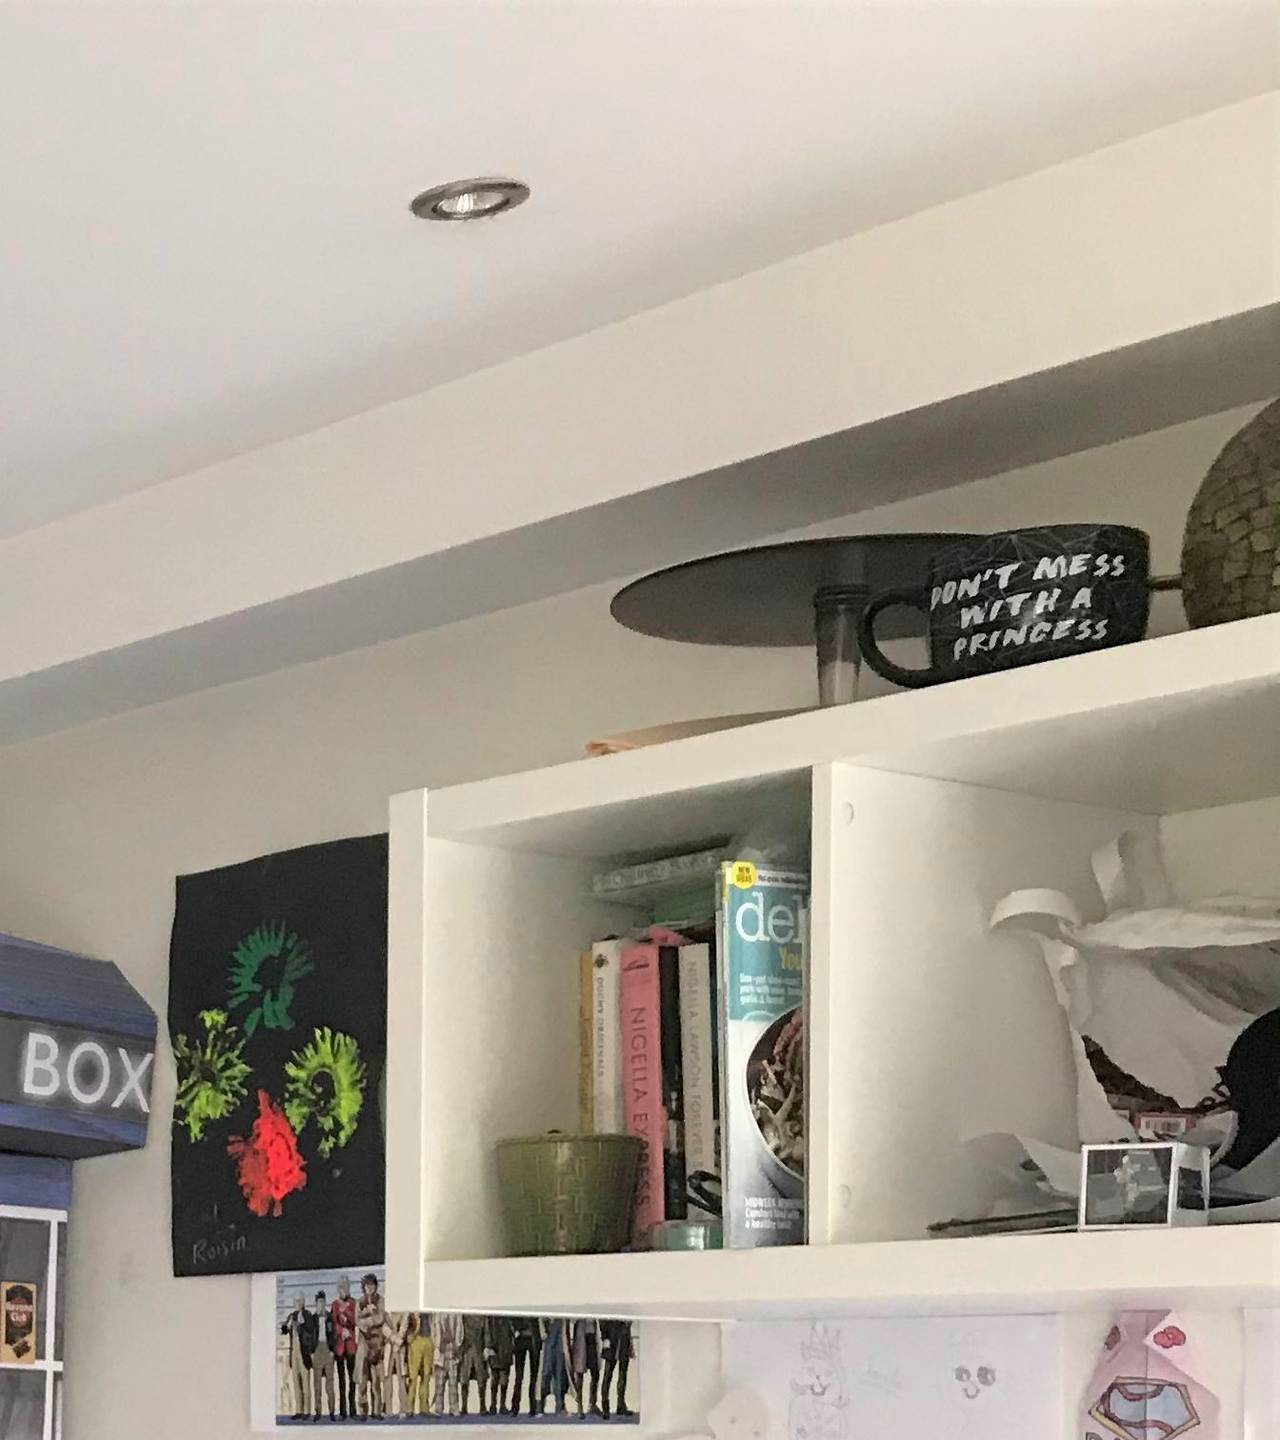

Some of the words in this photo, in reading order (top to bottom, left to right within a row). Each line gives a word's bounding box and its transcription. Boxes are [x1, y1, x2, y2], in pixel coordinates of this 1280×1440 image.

[930, 562, 1023, 611] DON'T
[1032, 554, 1125, 580] MESS
[961, 588, 1061, 629] WITH
[1071, 587, 1092, 608] A
[954, 619, 1109, 661] PRINCESS
[22, 1031, 154, 1113] BOX
[630, 1007, 648, 1101] NIGELLA
